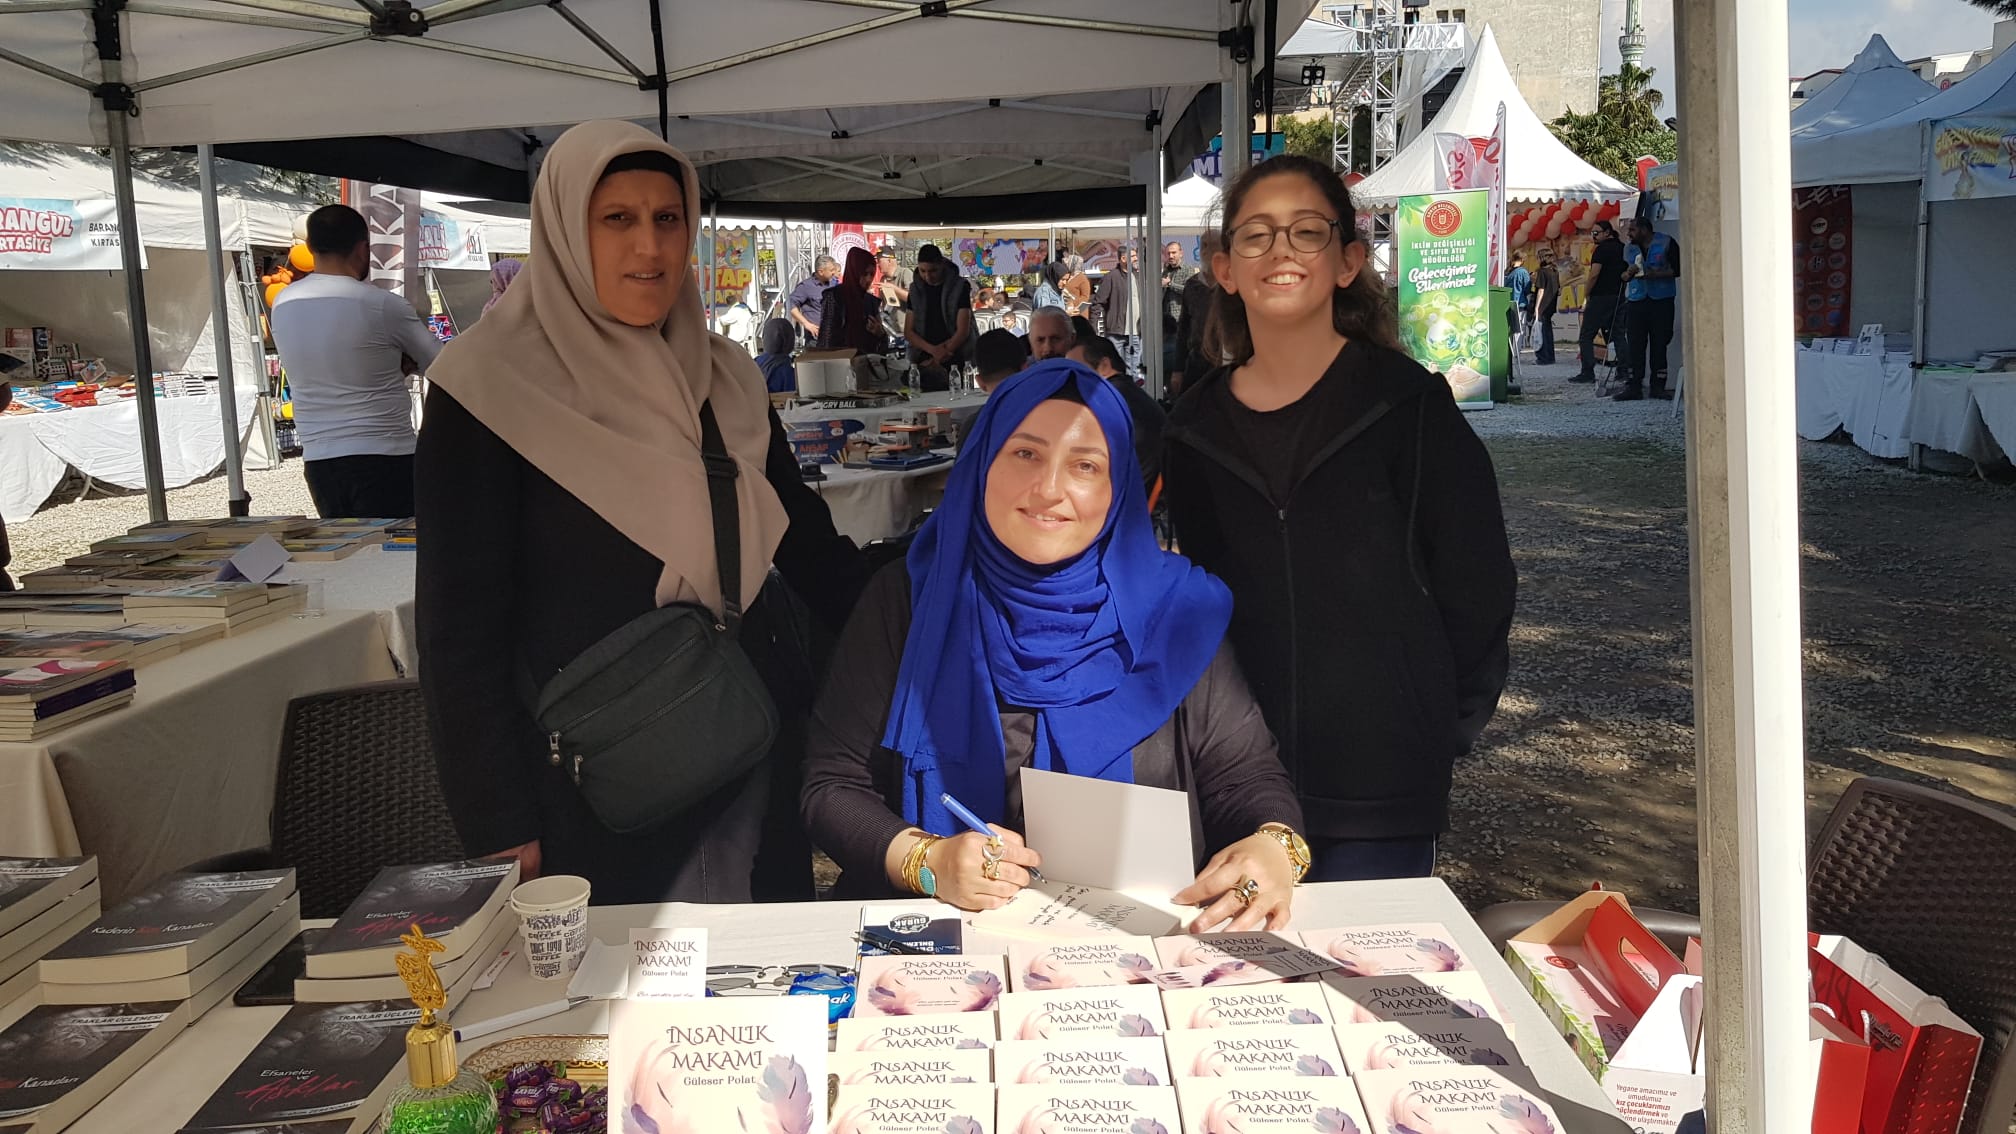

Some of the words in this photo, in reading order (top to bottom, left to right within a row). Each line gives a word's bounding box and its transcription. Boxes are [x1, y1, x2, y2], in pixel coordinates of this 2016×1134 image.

[1408, 263, 1478, 283] Geleceğimiz
[1415, 274, 1476, 293] Ellerimizde
[683, 1076, 724, 1086] Güleser
[727, 1075, 757, 1085] Polat
[1616, 1098, 1626, 1106] kız
[1626, 1101, 1671, 1111] çocuklarımızı
